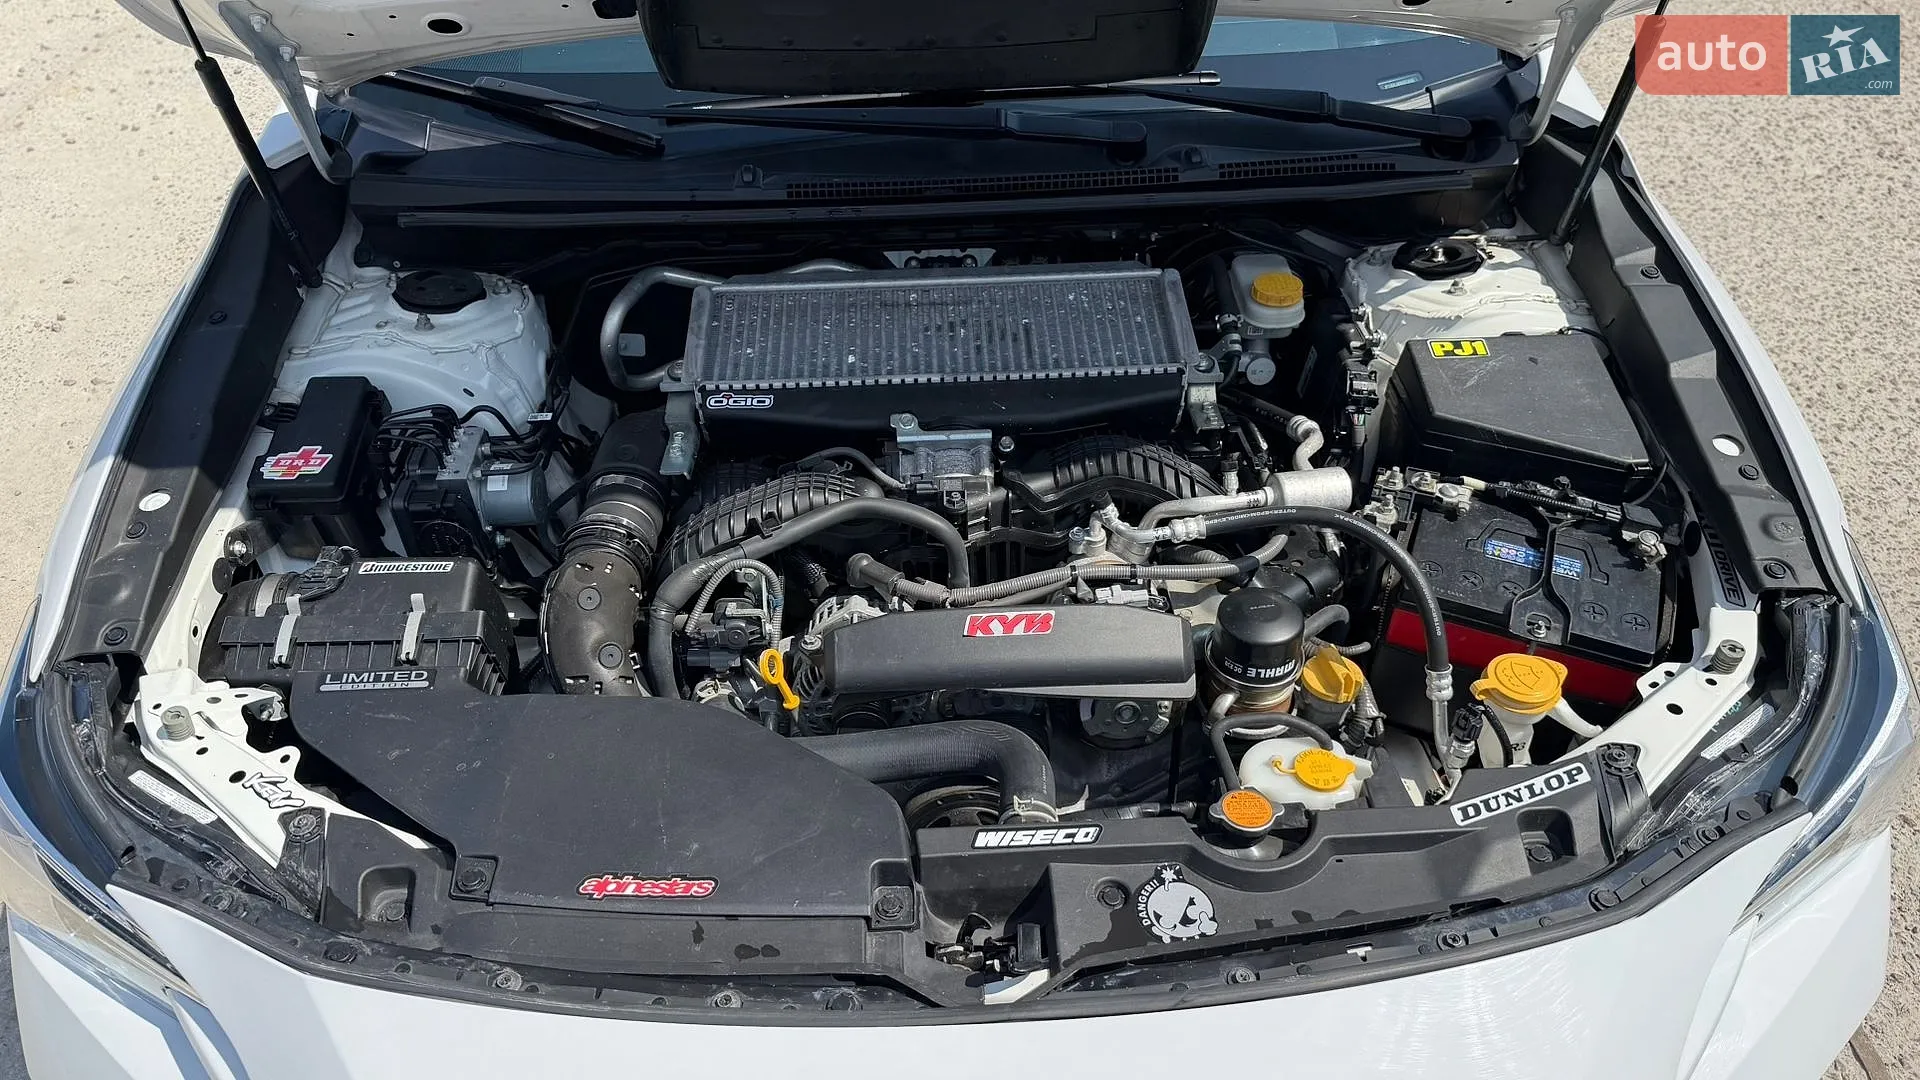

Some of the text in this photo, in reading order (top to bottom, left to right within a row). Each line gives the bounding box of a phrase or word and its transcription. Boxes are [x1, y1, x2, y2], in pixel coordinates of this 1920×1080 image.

[1430, 340, 1488, 357] PJ1
[709, 396, 771, 406] OGIO
[361, 562, 452, 573] BRIDGESTONE
[967, 612, 1054, 636] KYB
[325, 670, 428, 684] LIMITED
[1246, 658, 1296, 679] MAHLE
[1457, 765, 1584, 823] DUNLOP
[974, 826, 1100, 848] WISECO
[580, 874, 716, 899] alpinestars
